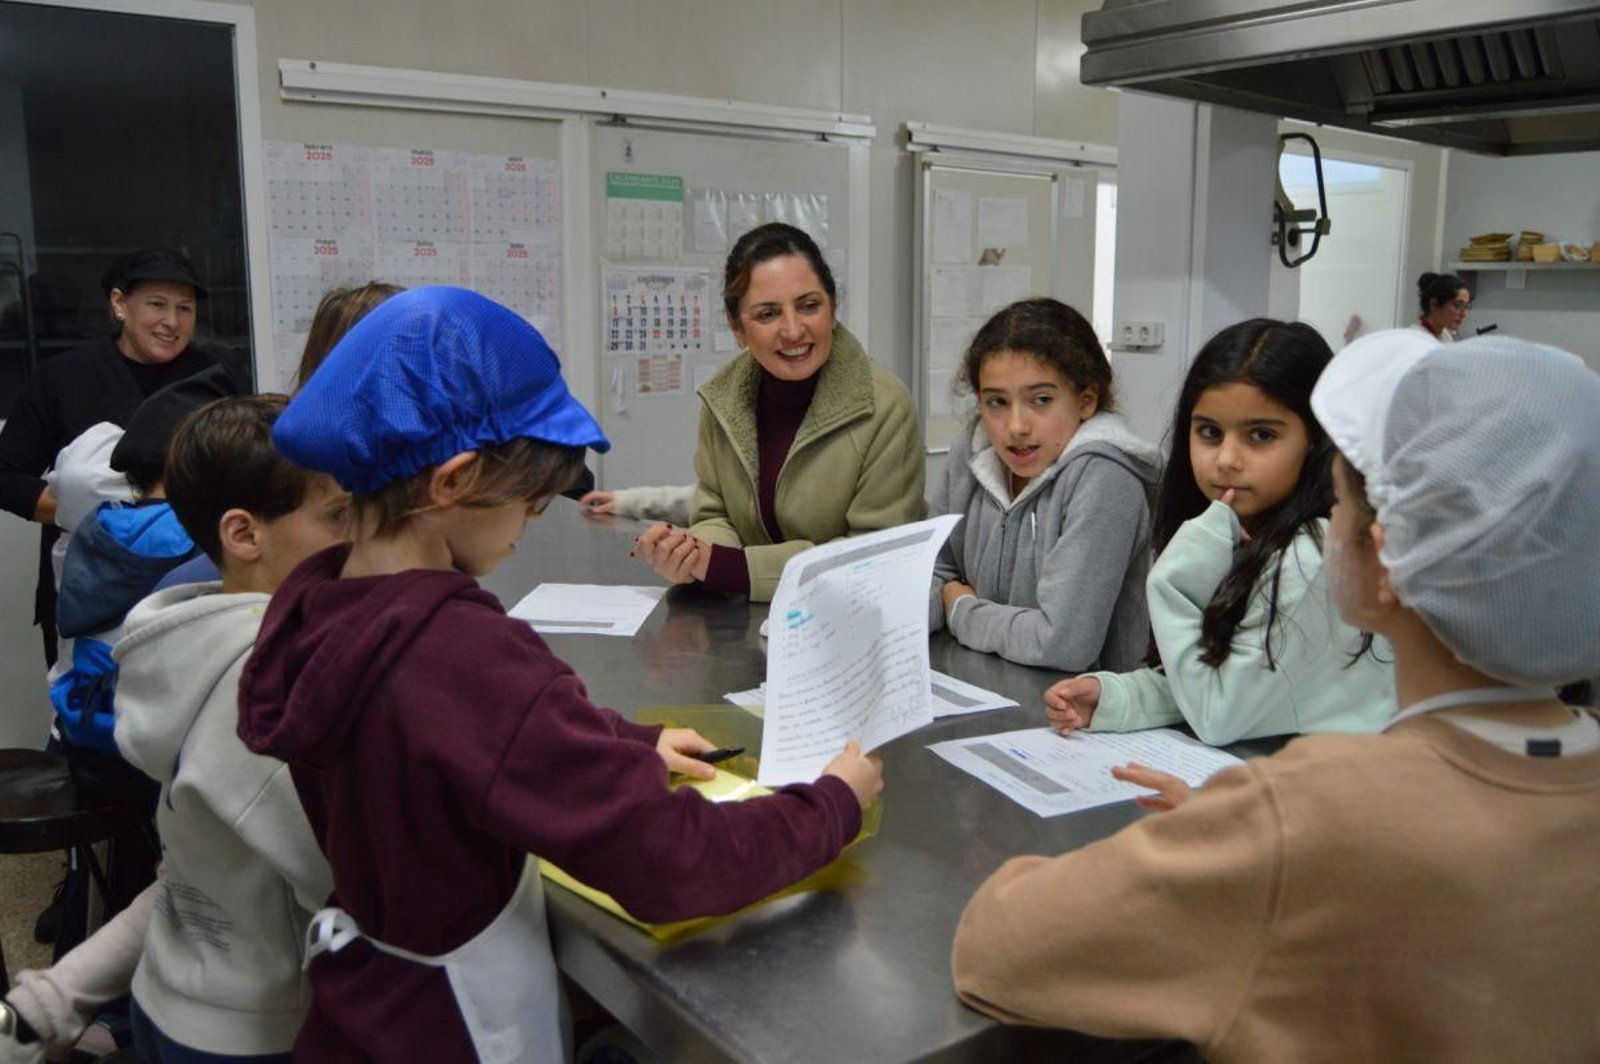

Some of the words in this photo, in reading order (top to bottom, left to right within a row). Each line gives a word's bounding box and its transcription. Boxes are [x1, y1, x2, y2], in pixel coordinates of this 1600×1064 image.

[306, 151, 333, 160] 2025
[410, 157, 434, 166] 2025
[504, 162, 527, 171] 2025
[313, 246, 338, 256] 2025
[413, 248, 438, 257] 2025
[506, 249, 529, 258] 2025
